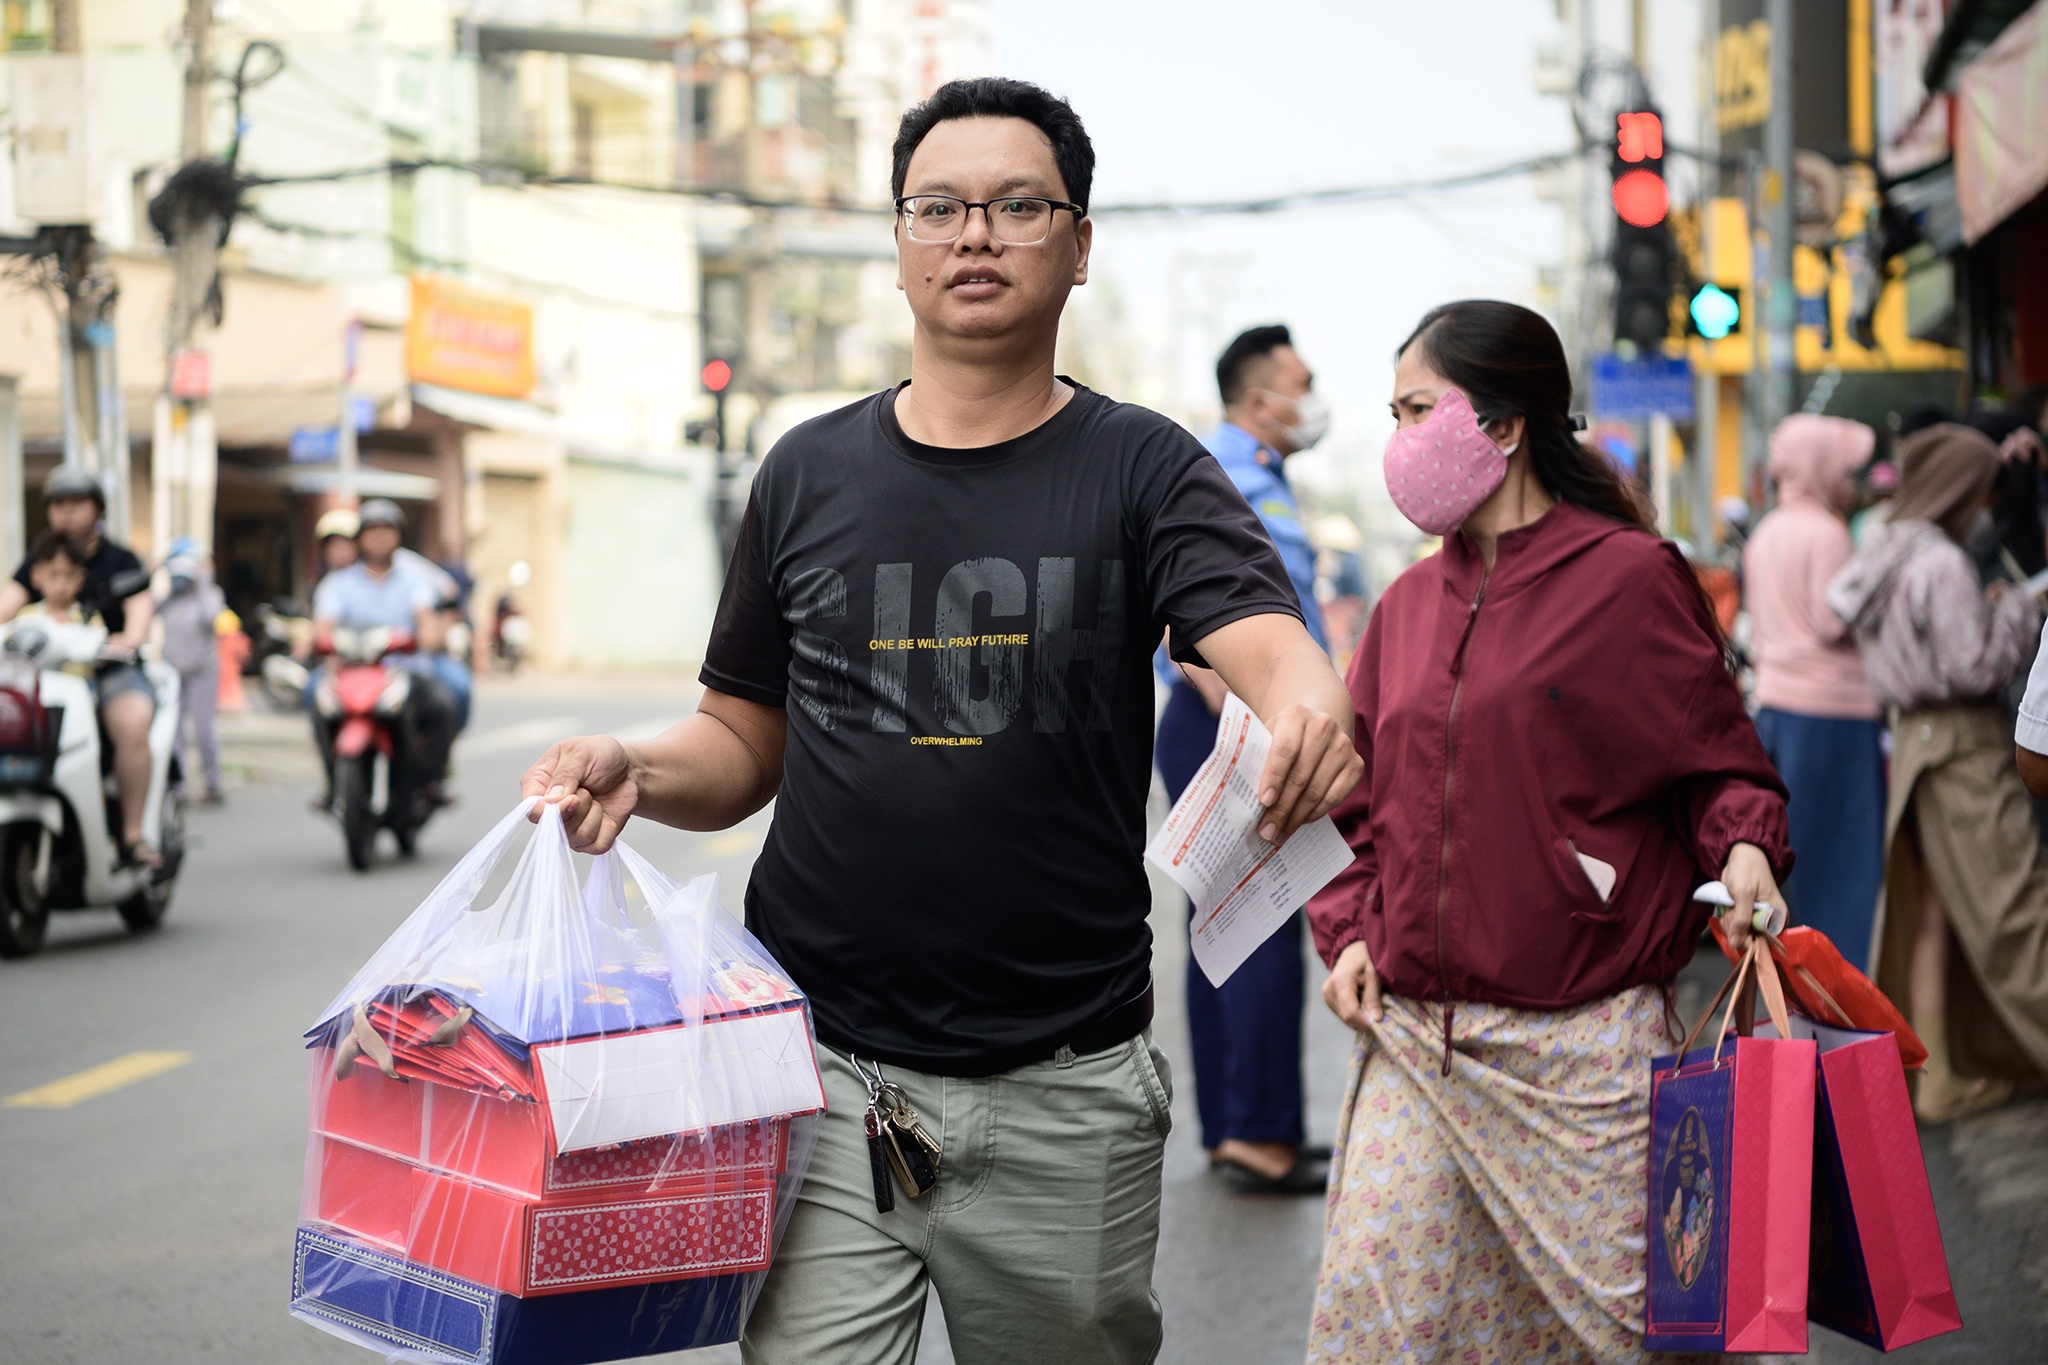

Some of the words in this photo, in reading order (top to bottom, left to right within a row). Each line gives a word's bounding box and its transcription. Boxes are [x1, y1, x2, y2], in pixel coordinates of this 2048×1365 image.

[869, 639, 895, 650] ONE
[898, 639, 915, 649] BE
[917, 638, 945, 649] WILL
[949, 636, 980, 648] PRAY
[981, 634, 1029, 646] FUTHRE
[910, 736, 983, 746] OVERWHELMING
